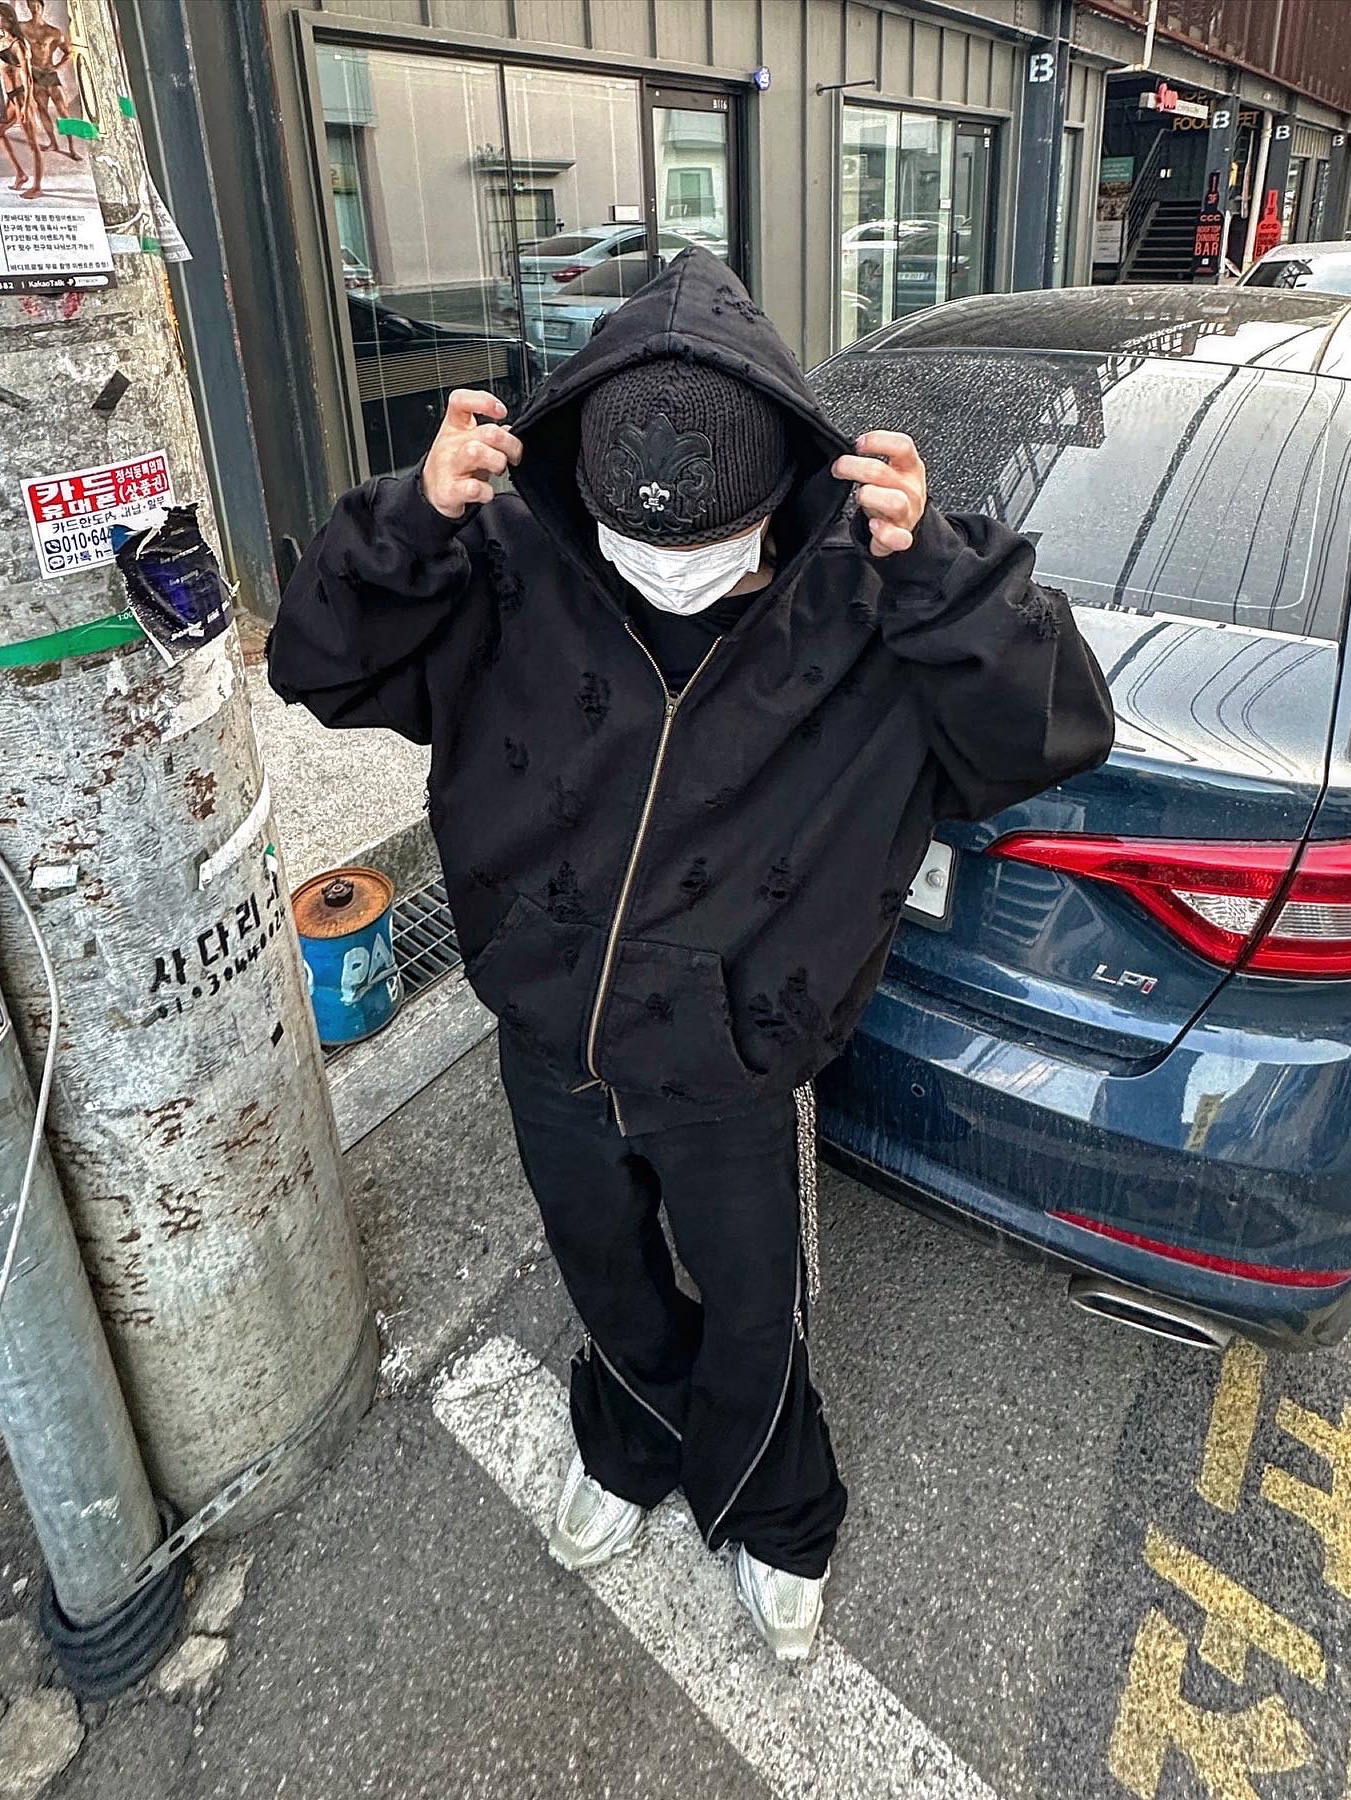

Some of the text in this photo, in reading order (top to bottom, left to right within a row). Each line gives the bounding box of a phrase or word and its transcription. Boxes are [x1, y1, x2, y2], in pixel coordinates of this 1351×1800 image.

[1029, 53, 1053, 83] B
[1212, 110, 1230, 129] B
[1275, 125, 1291, 140] B
[1332, 134, 1345, 147] B
[1194, 242, 1219, 256] BAR
[28, 280, 65, 288] KakaoTalk
[35, 472, 116, 505] 카드
